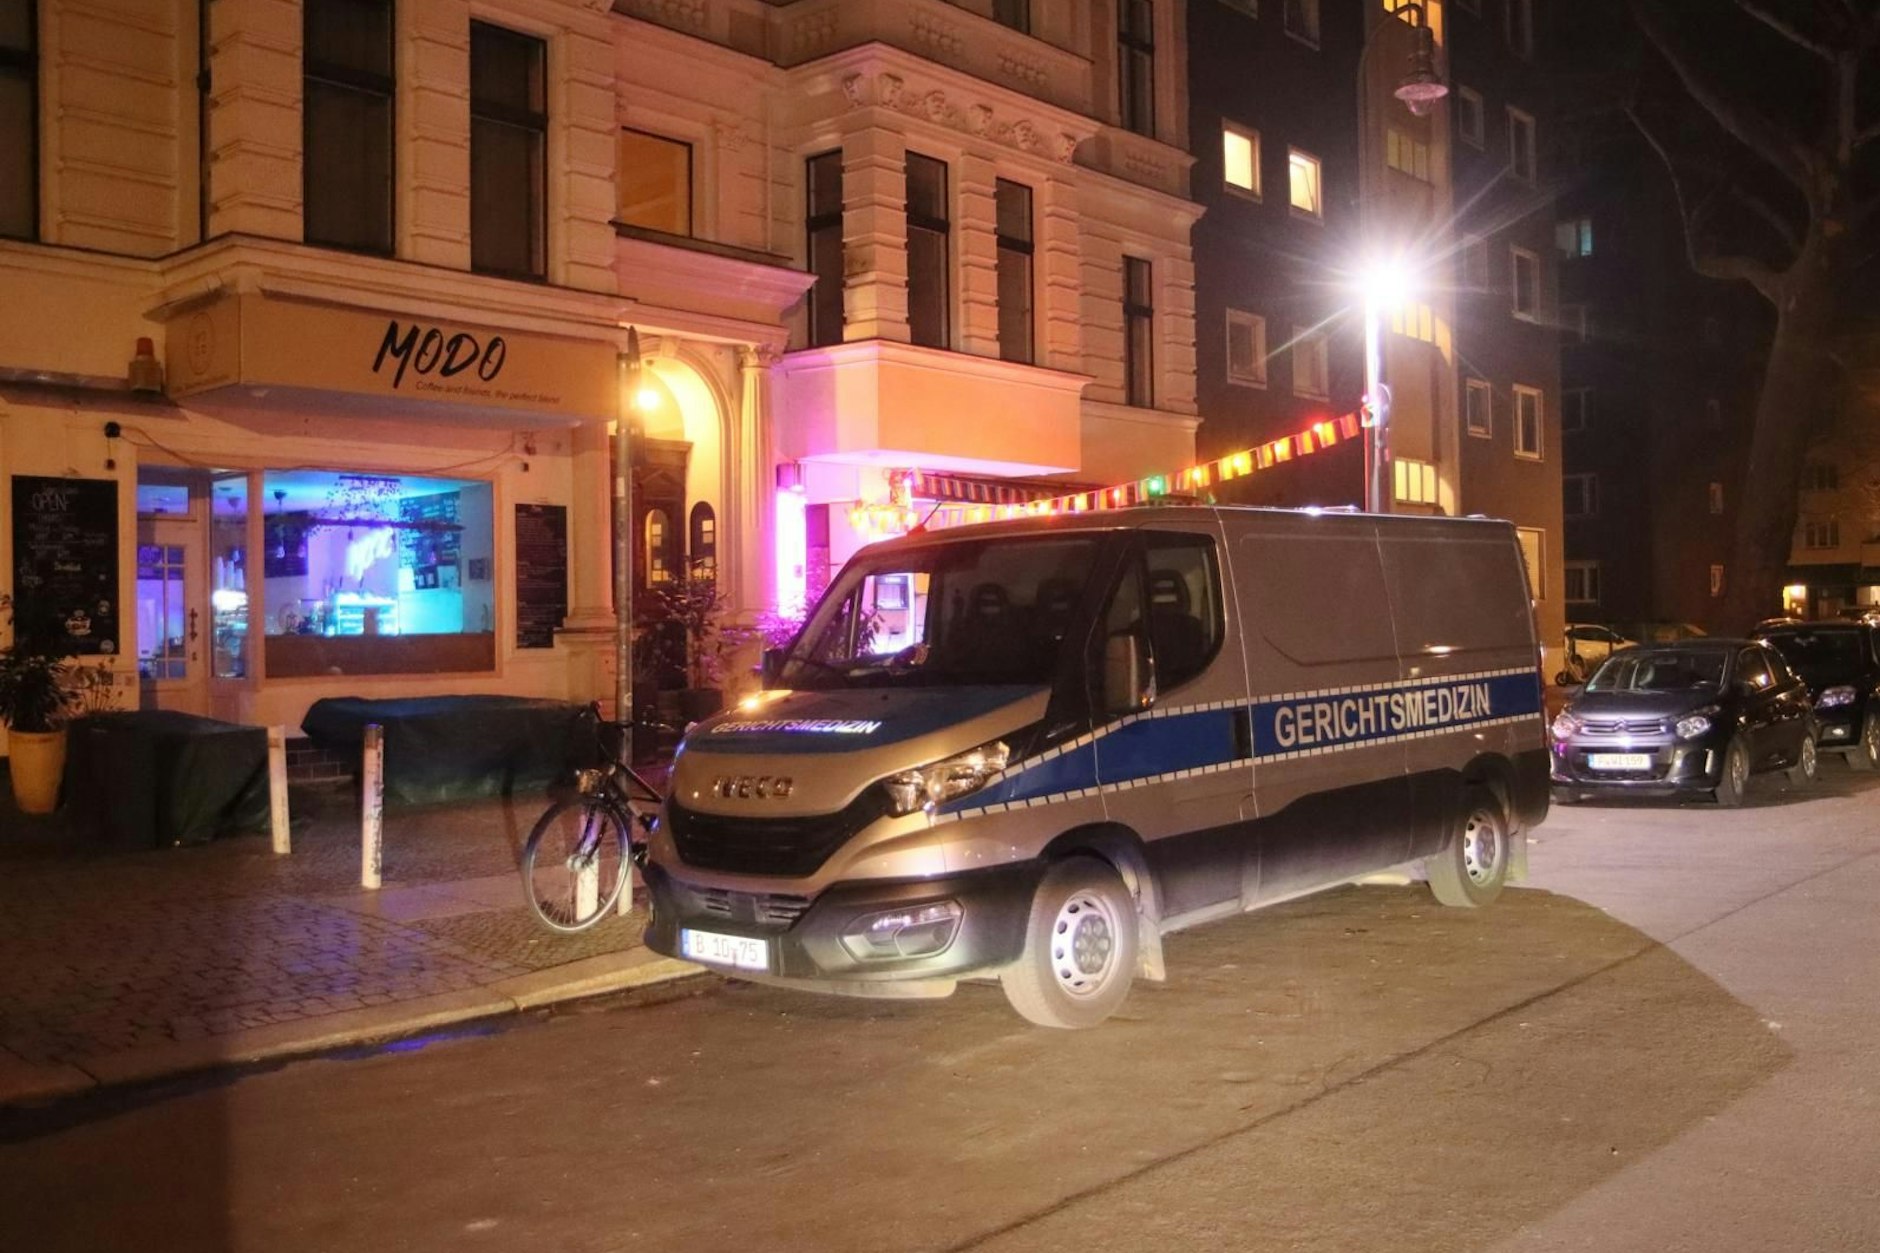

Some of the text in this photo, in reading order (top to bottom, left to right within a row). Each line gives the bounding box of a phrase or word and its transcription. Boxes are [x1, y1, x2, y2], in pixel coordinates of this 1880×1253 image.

[372, 320, 506, 389] MODO
[711, 718, 883, 735] GERICHTSMEDIZIN
[1273, 682, 1491, 748] GERICHTSMEDIZIN
[712, 775, 794, 799] IVECO
